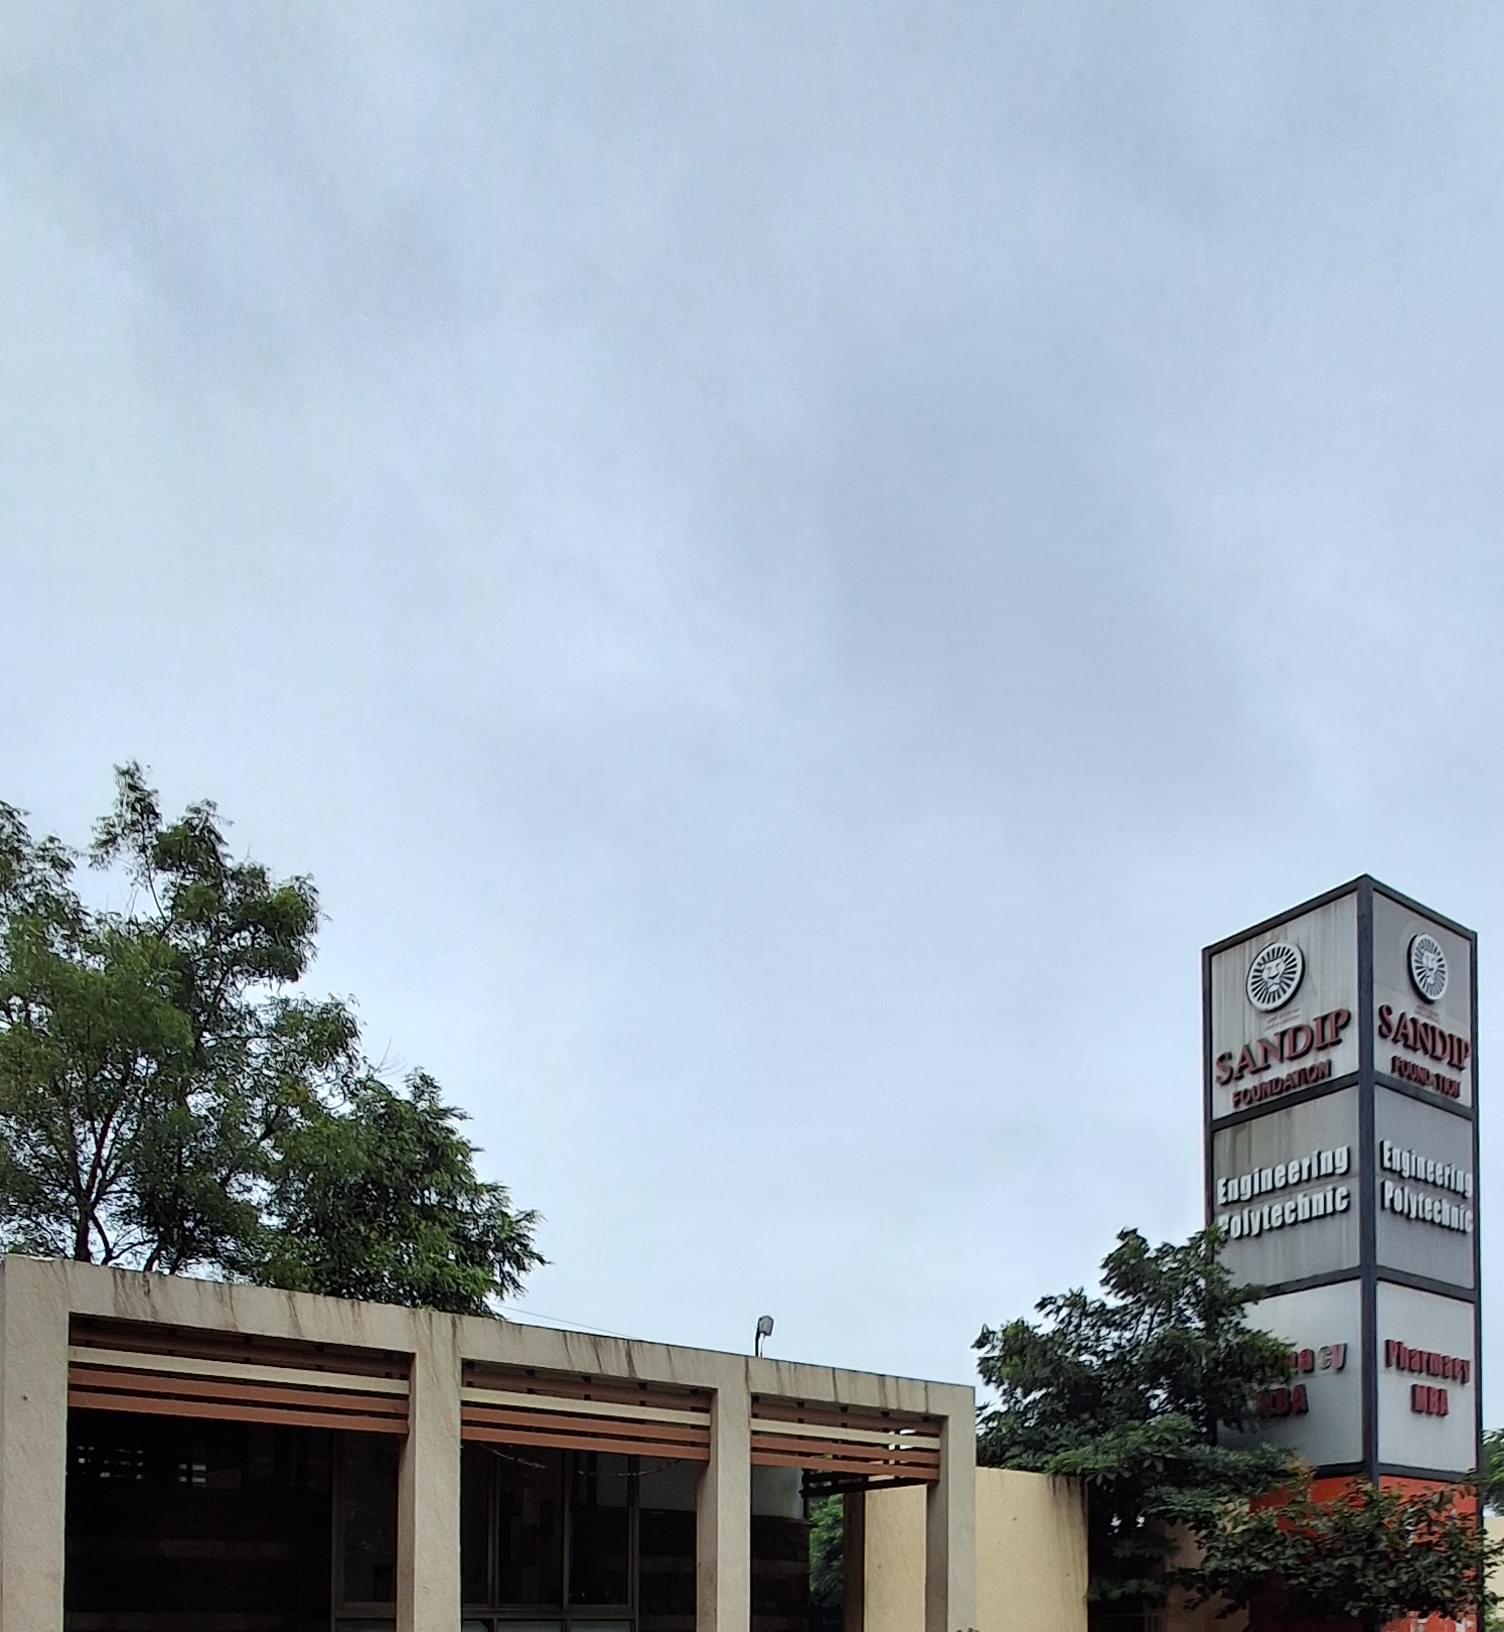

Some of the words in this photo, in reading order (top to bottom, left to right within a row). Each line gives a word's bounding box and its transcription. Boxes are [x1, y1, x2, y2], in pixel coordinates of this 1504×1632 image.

[1215, 1008, 1351, 1087] SANDIP
[1378, 1004, 1471, 1071] SANDIP
[1232, 1059, 1332, 1108] FOUNDATION
[1391, 1055, 1461, 1099] FOUNDTION
[1217, 1145, 1349, 1206] Engineering
[1380, 1139, 1472, 1199] Engineering
[1217, 1186, 1349, 1239] Polytechnic
[1381, 1180, 1473, 1234] Polytechnic
[1385, 1339, 1470, 1385] Pharmacy
[1411, 1384, 1448, 1417] MBA
